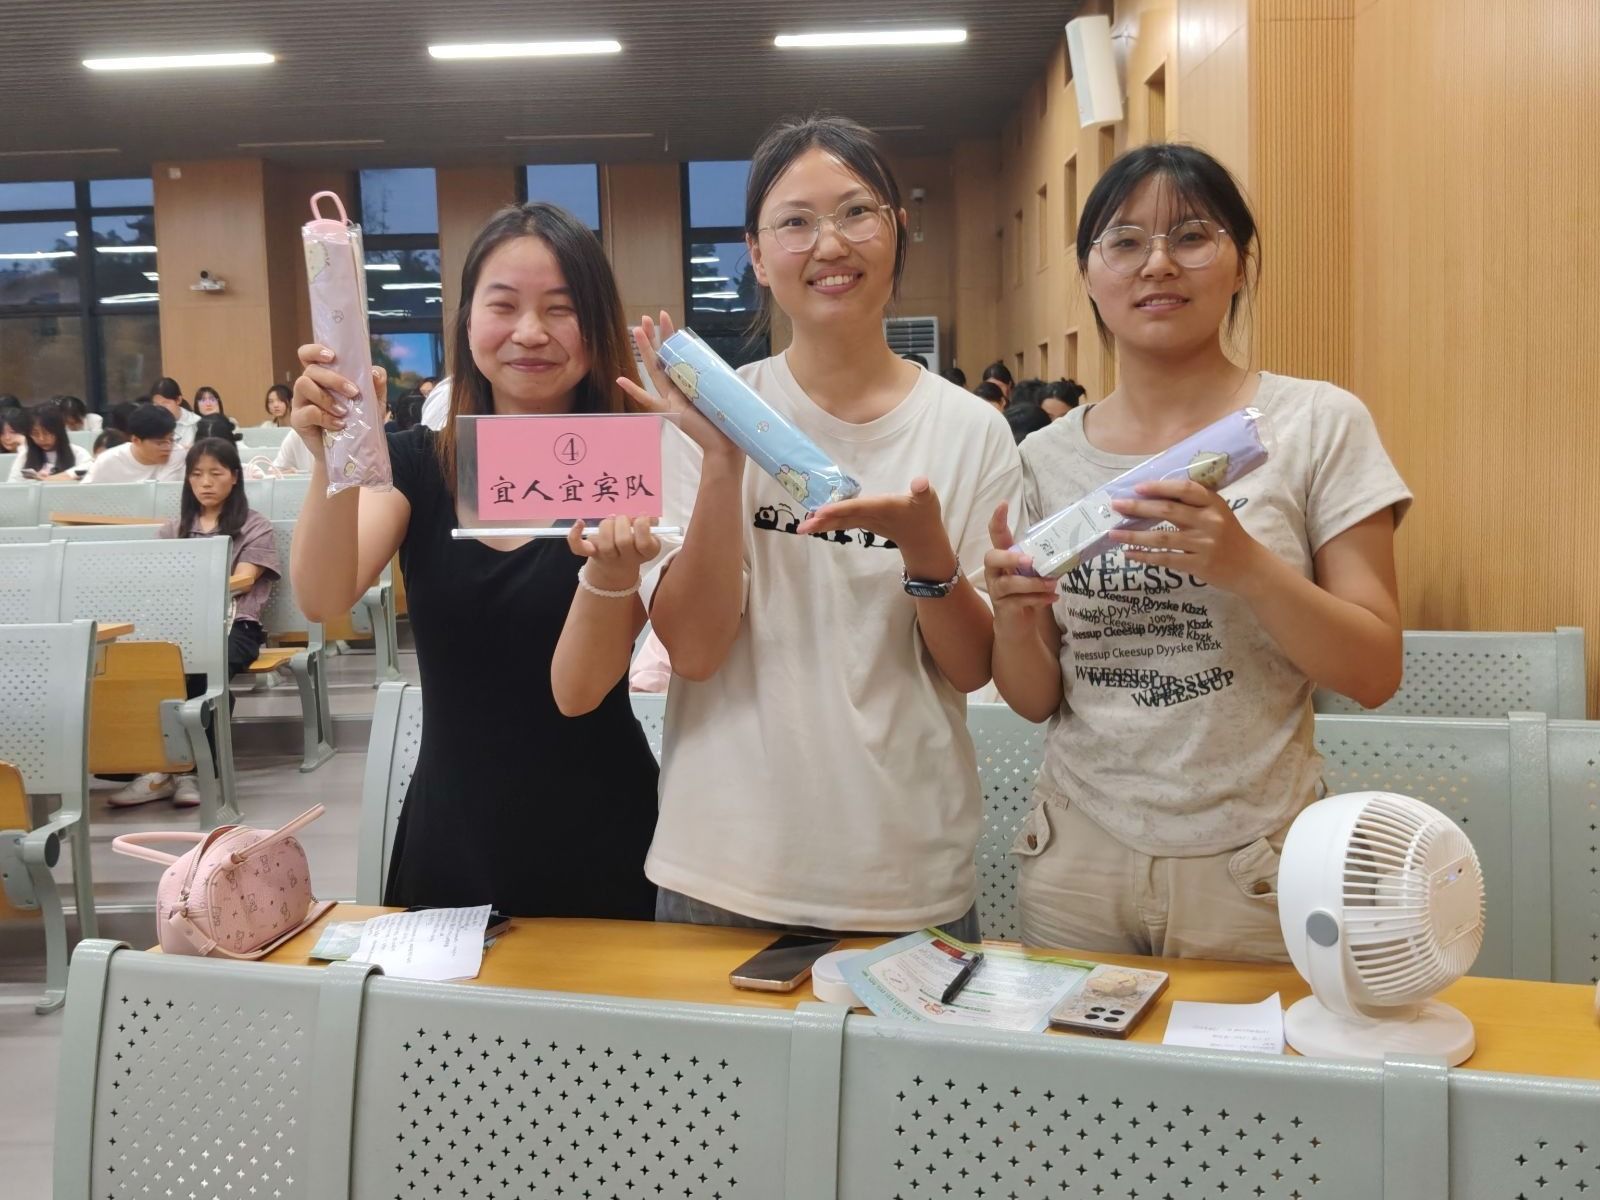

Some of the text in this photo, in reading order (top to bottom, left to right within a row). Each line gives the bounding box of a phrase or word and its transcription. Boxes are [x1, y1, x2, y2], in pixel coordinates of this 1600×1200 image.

[490, 471, 656, 504] 宜人宜宾队
[1181, 602, 1208, 616] Kbzk
[1186, 618, 1214, 631] Kbzk
[1112, 647, 1154, 659] Ckeesup
[1156, 643, 1194, 657] Dyyske
[1195, 640, 1223, 652] Kbzk
